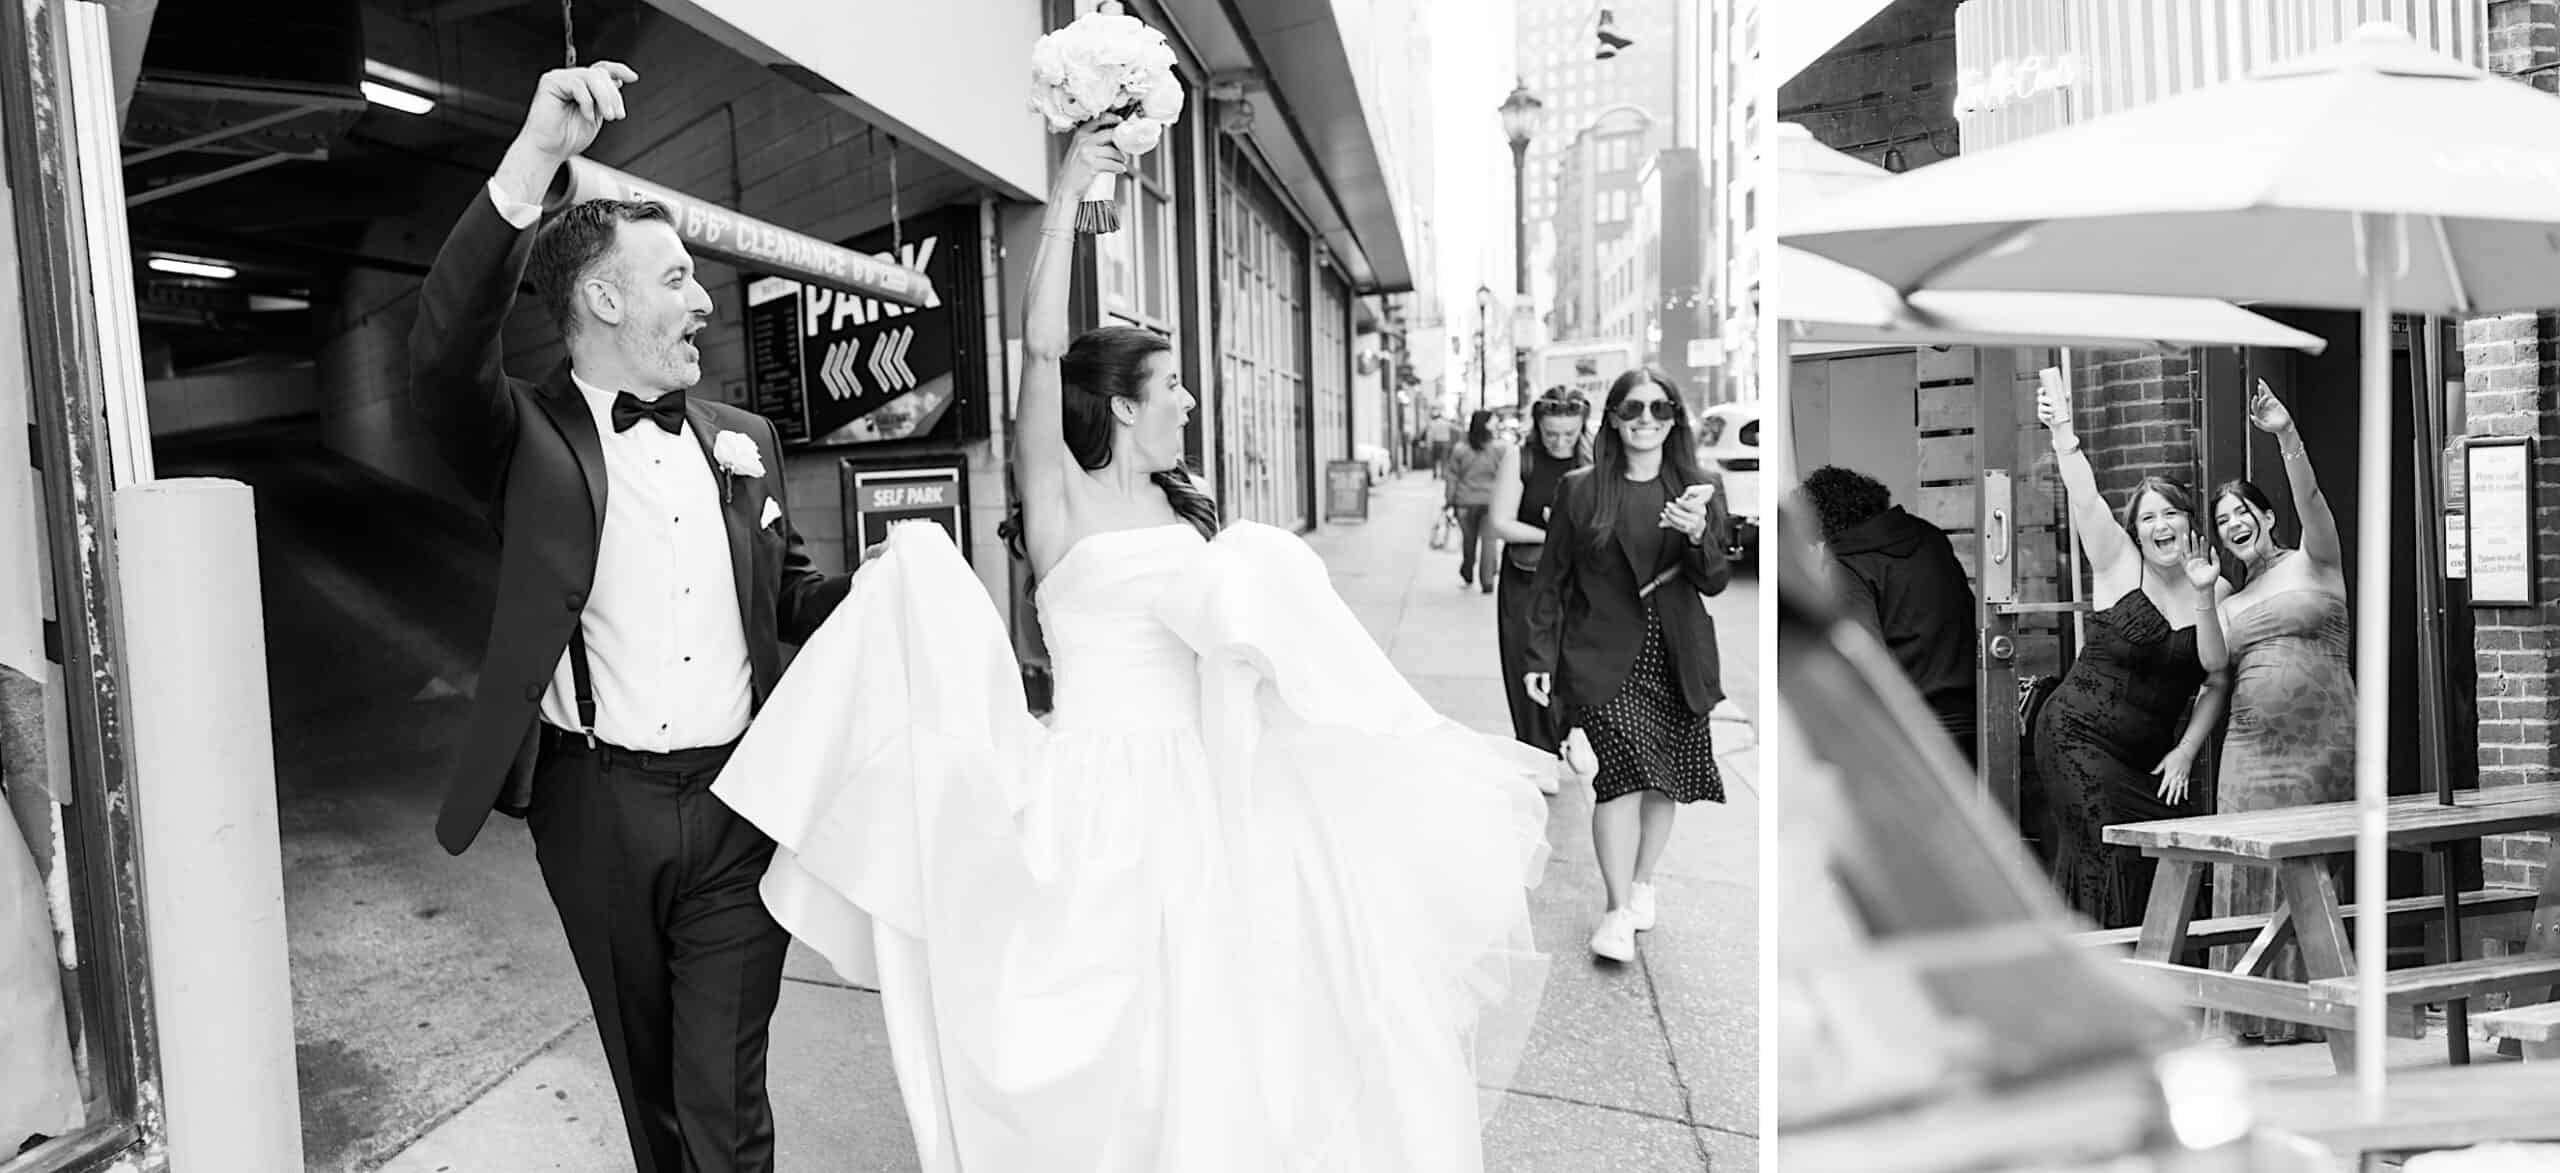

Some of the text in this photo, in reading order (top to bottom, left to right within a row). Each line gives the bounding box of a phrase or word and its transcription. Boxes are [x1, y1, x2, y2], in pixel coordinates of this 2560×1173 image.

[736, 219, 847, 278] CLEARANCE
[873, 485, 944, 507] SELF PARK
